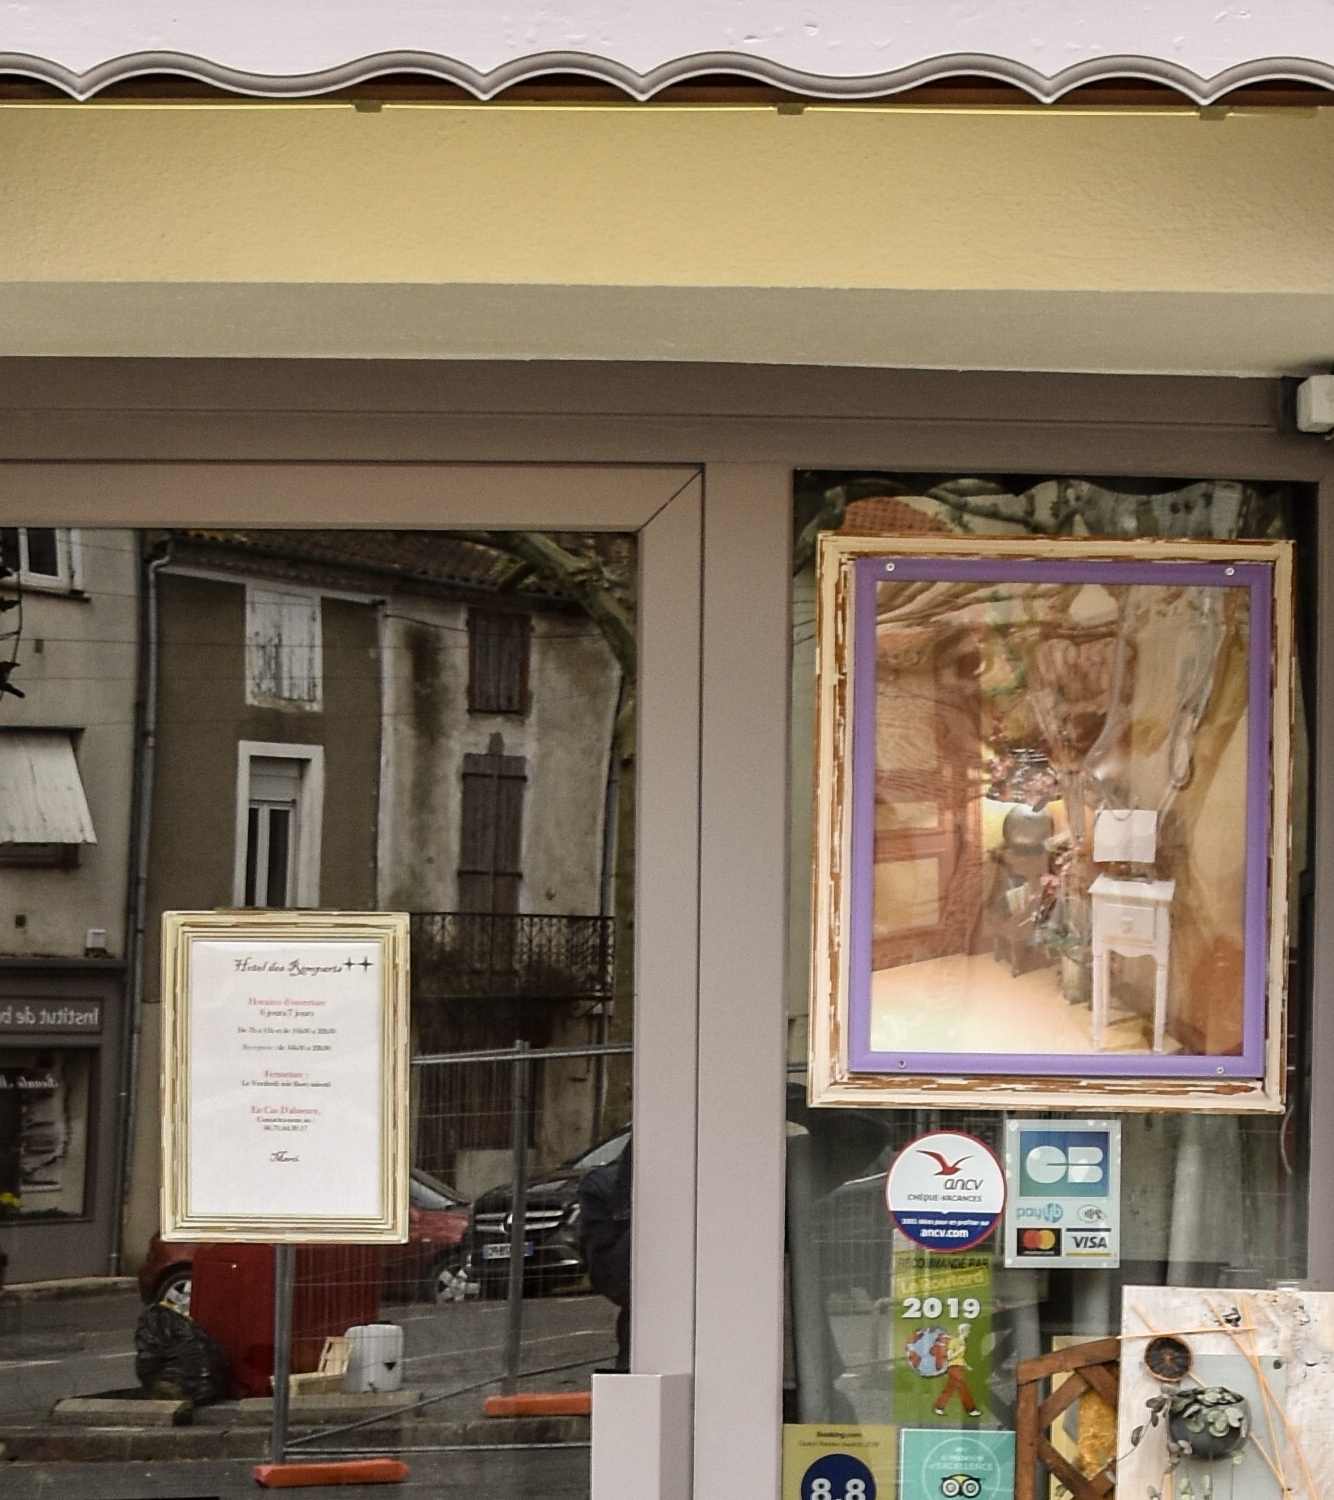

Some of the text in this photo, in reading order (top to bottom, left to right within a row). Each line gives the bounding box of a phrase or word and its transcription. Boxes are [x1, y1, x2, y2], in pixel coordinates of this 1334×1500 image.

[943, 1178, 985, 1191] ancv
[919, 1228, 969, 1239] ancv.com
[1072, 1235, 1108, 1249] VISA
[901, 1297, 981, 1319] 2019
